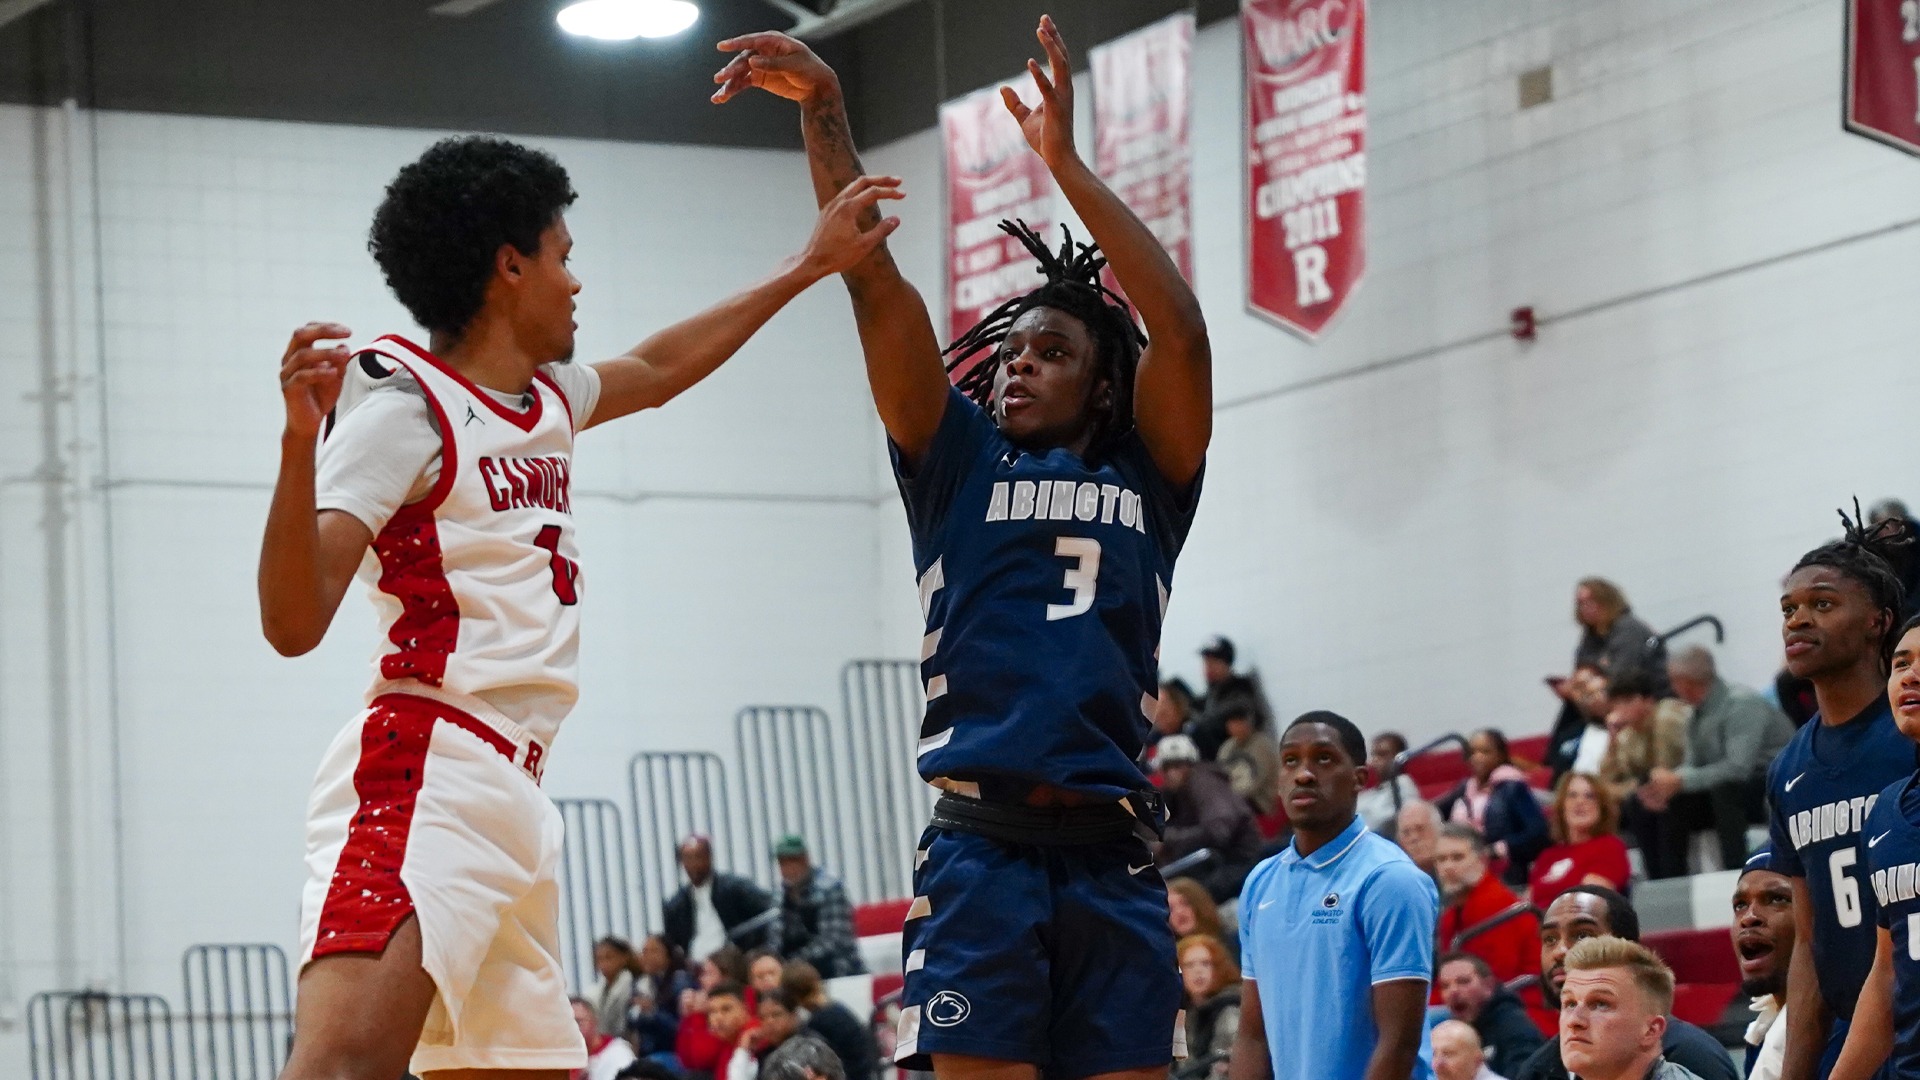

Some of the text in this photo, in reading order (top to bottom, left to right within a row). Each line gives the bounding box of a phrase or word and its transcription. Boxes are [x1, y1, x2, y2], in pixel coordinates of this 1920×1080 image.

[1294, 246, 1333, 306] R
[478, 456, 572, 515] CAMDEN
[1046, 536, 1102, 621] 3
[1828, 846, 1862, 928] 6
